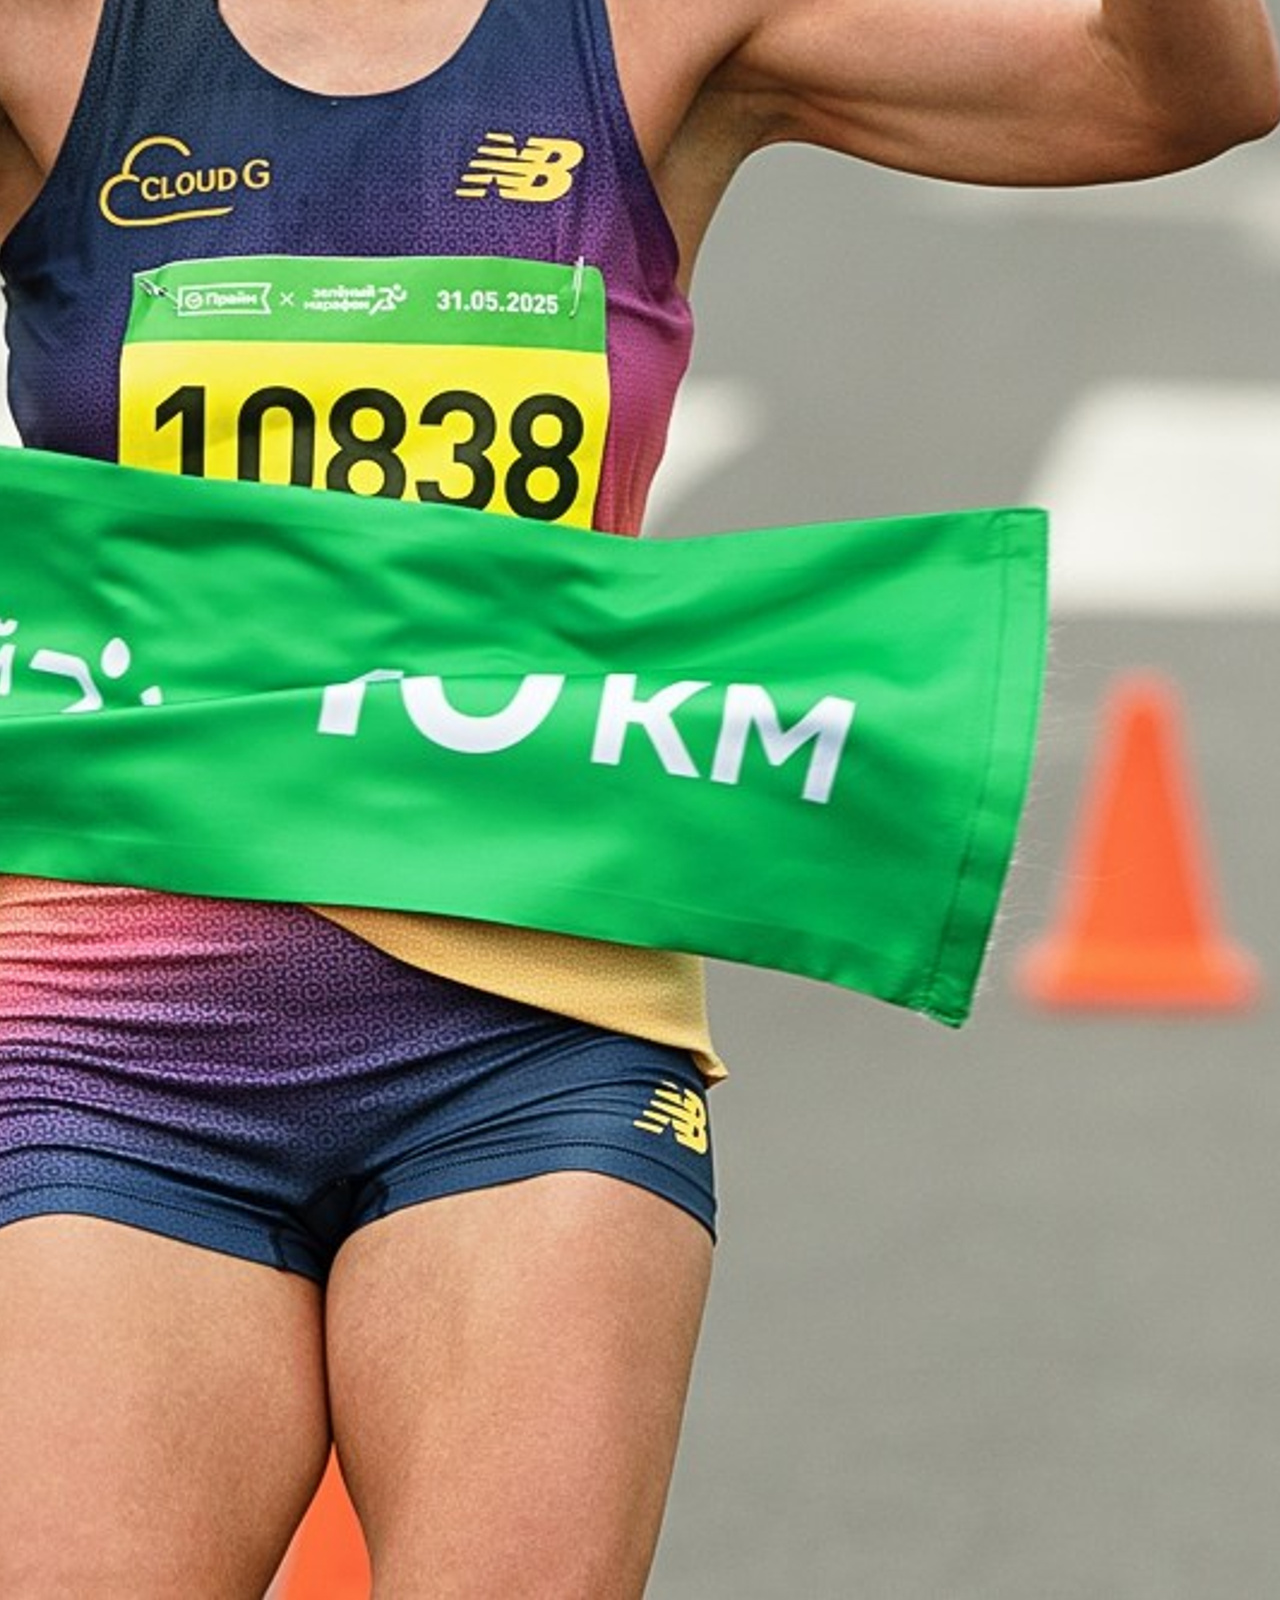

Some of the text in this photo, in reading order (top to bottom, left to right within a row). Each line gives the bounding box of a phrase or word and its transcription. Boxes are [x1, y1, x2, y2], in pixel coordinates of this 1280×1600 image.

[141, 159, 271, 202] CLOUD G
[436, 289, 559, 315] 31.05.2025
[154, 385, 585, 523] 10838
